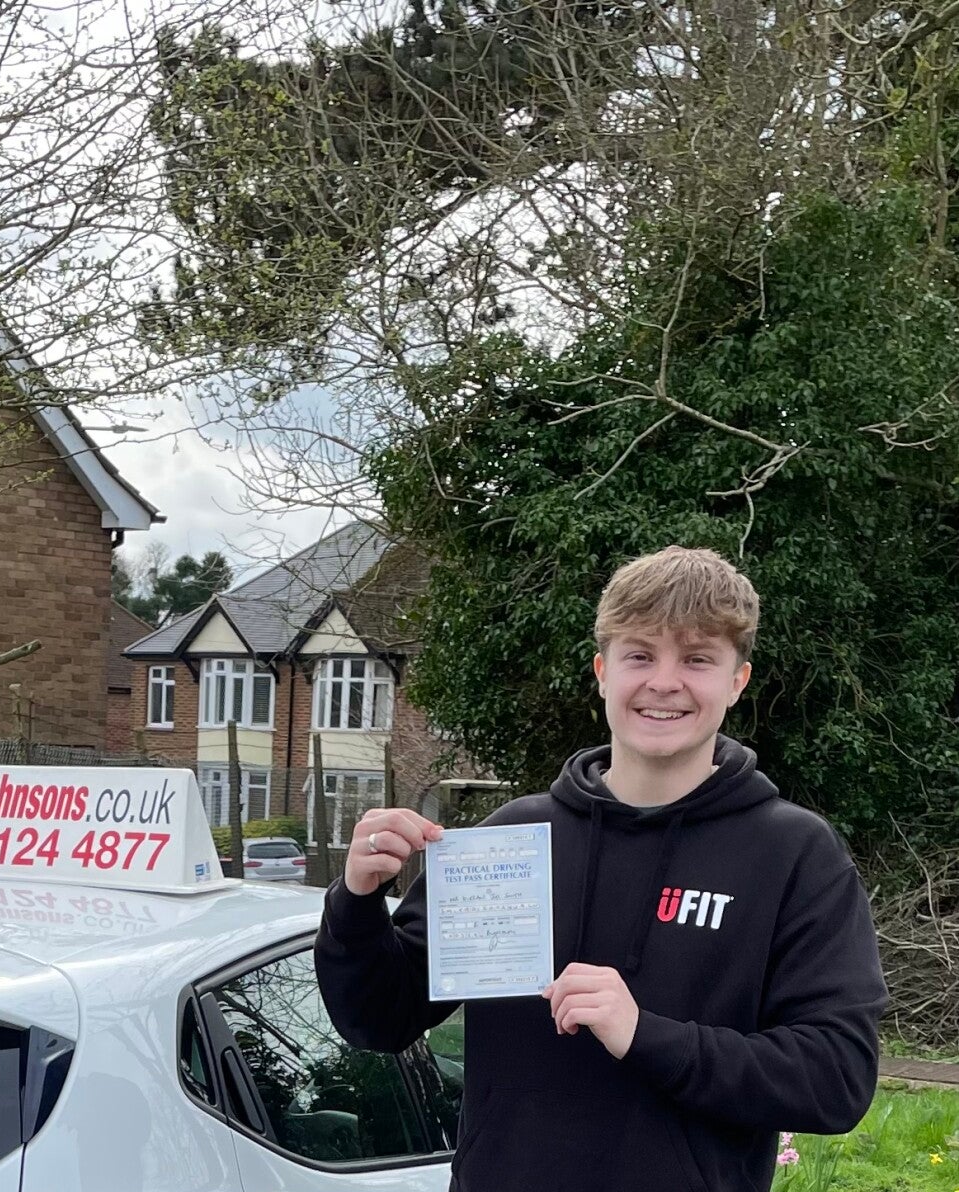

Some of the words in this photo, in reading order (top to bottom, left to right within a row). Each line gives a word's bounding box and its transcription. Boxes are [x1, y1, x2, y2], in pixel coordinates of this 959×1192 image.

[71, 830, 171, 872] 4877
[444, 865, 490, 875] PRACTICAL
[493, 862, 531, 872] DRIVING
[444, 875, 462, 883] TEST
[464, 874, 482, 882] PASS
[484, 871, 531, 881] CERTIFICATE
